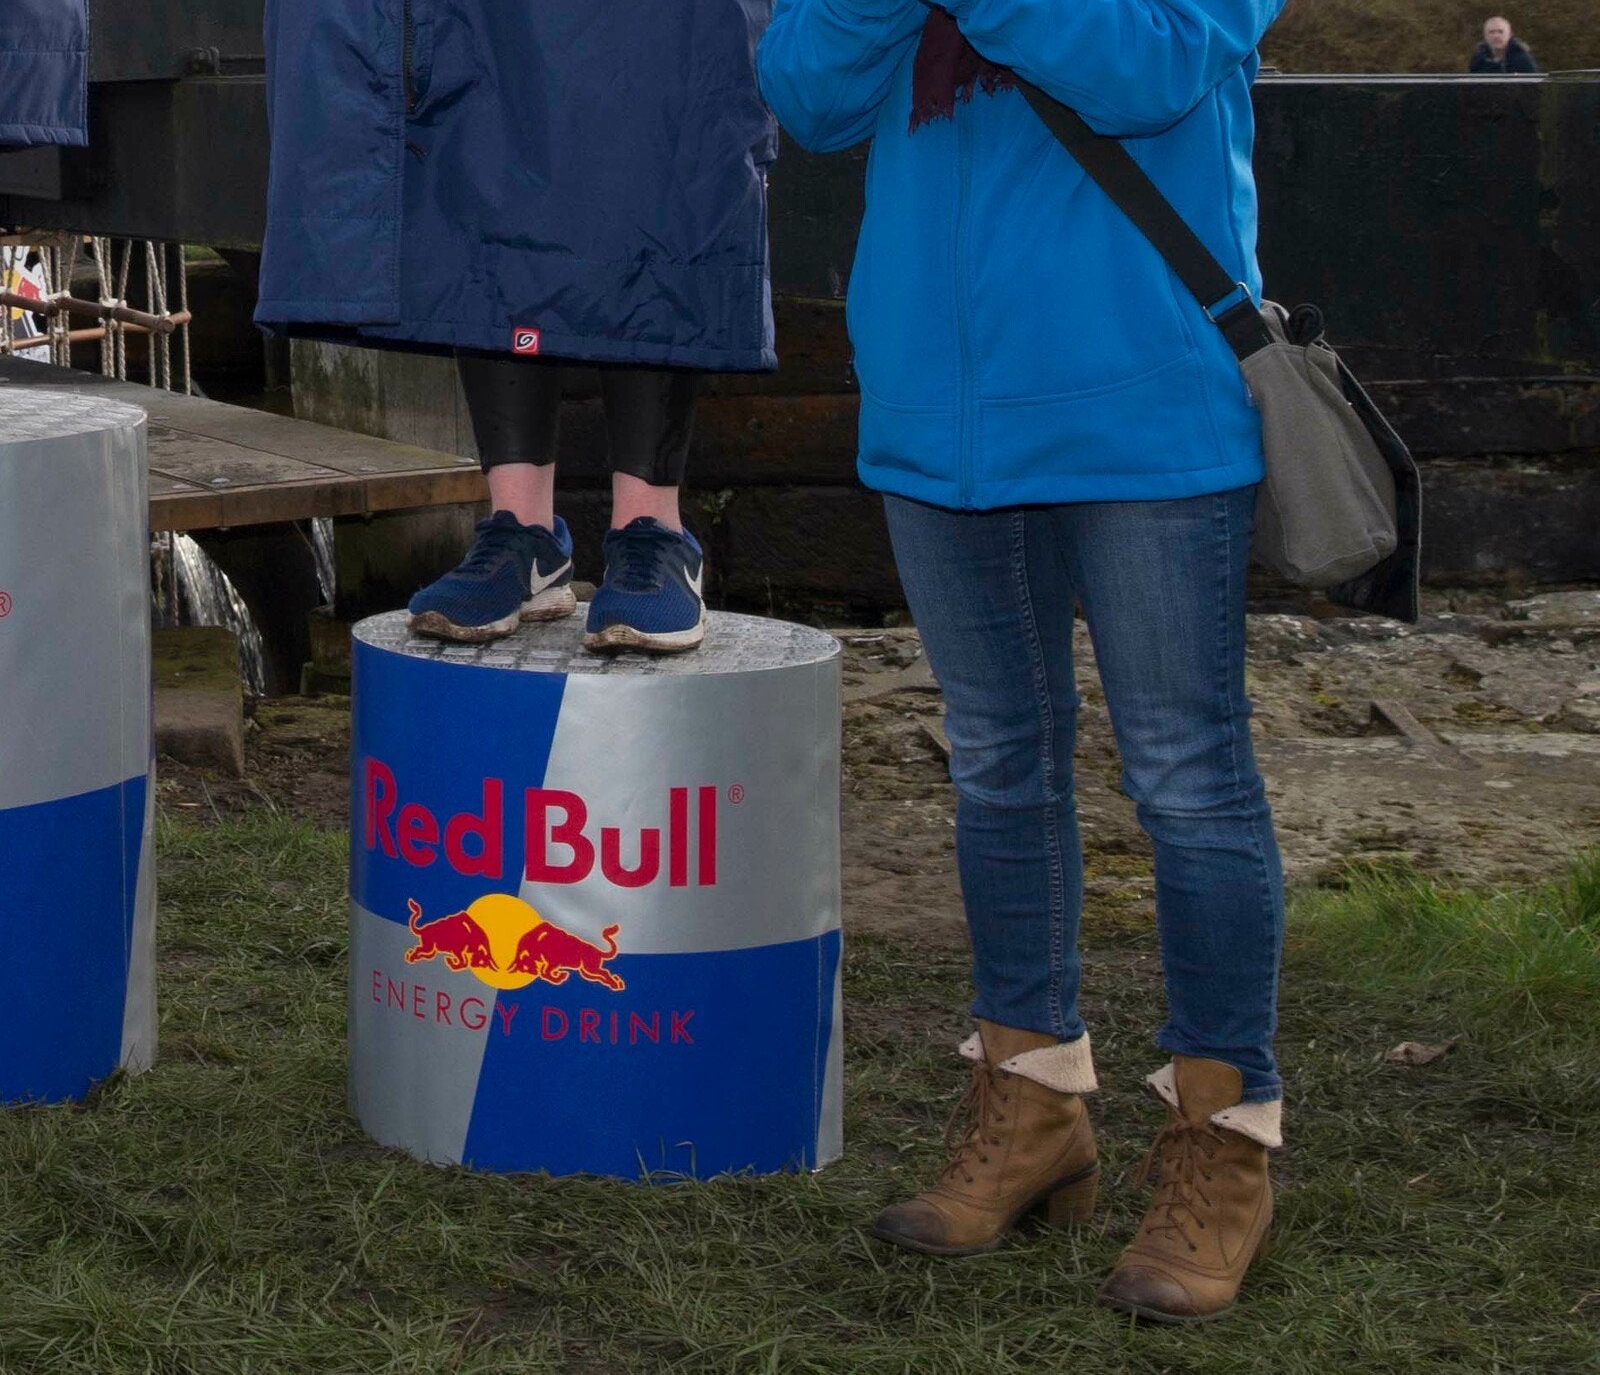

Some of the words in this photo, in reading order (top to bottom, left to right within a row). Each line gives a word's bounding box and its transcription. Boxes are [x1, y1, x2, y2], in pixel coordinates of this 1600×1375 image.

[365, 756, 503, 880] Red
[372, 969, 519, 1036] ENERGY
[541, 1009, 696, 1045] DRINK
